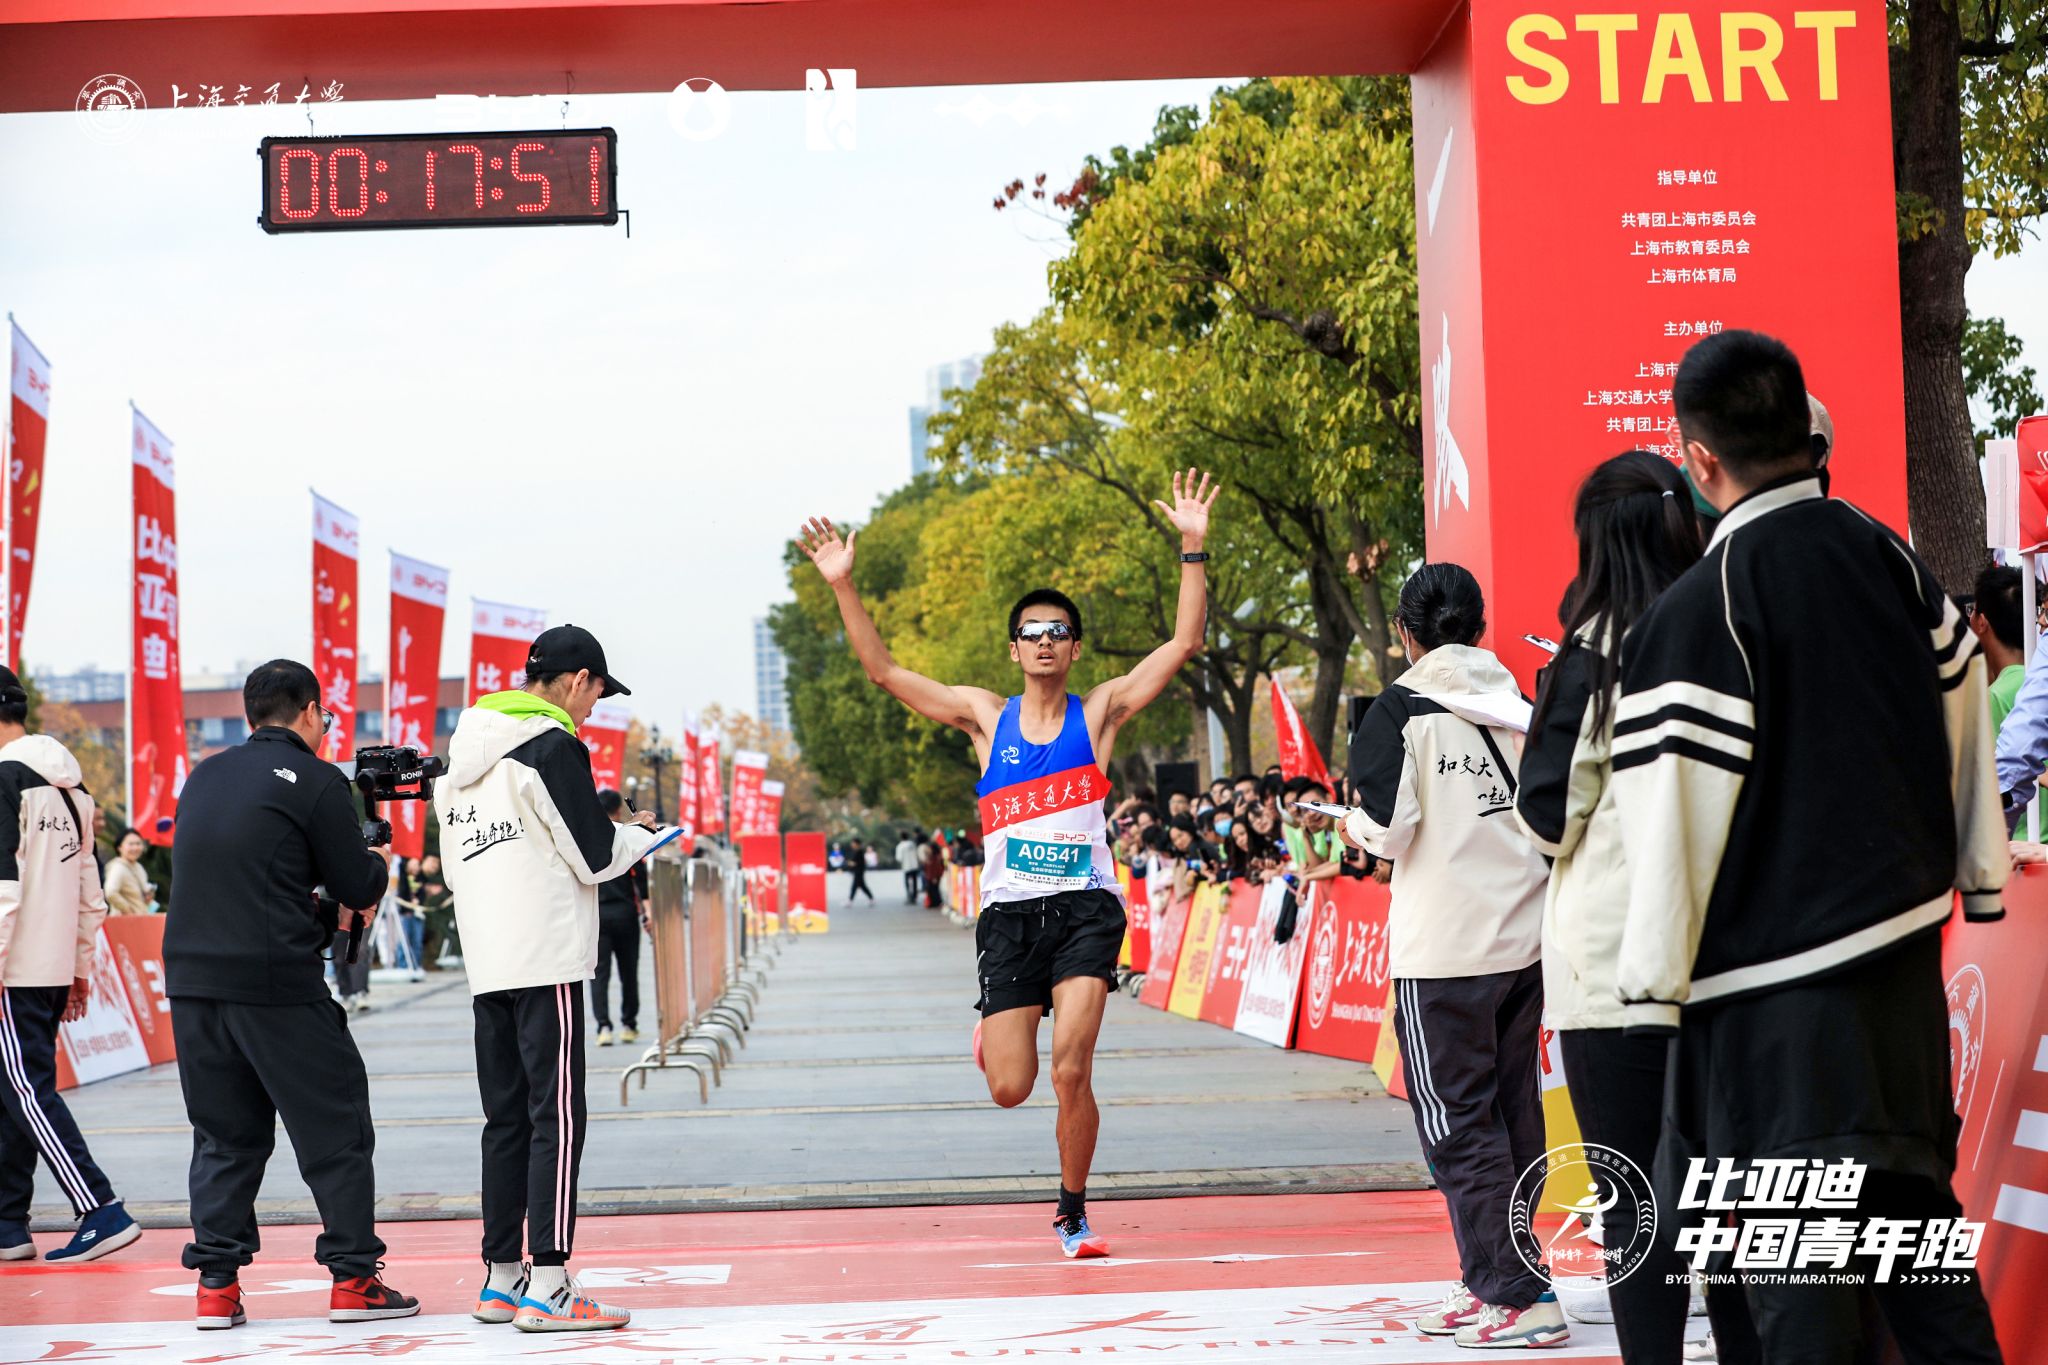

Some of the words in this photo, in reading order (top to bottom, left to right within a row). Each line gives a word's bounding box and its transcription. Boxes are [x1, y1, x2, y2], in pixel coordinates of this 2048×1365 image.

[1505, 11, 1857, 104] START
[279, 143, 600, 219] 00:17:51
[1657, 169, 1718, 186] 指导单位
[1621, 211, 1757, 228] 共青团上海市委员会
[1630, 239, 1751, 256] 上海市教育委员会
[1647, 268, 1737, 284] 上海市体育局
[1664, 320, 1723, 336] 主办单位
[1437, 754, 1494, 778] 和交大
[401, 769, 423, 781] RONIN
[1053, 832, 1087, 842] BYD
[1018, 843, 1079, 863] A0541
